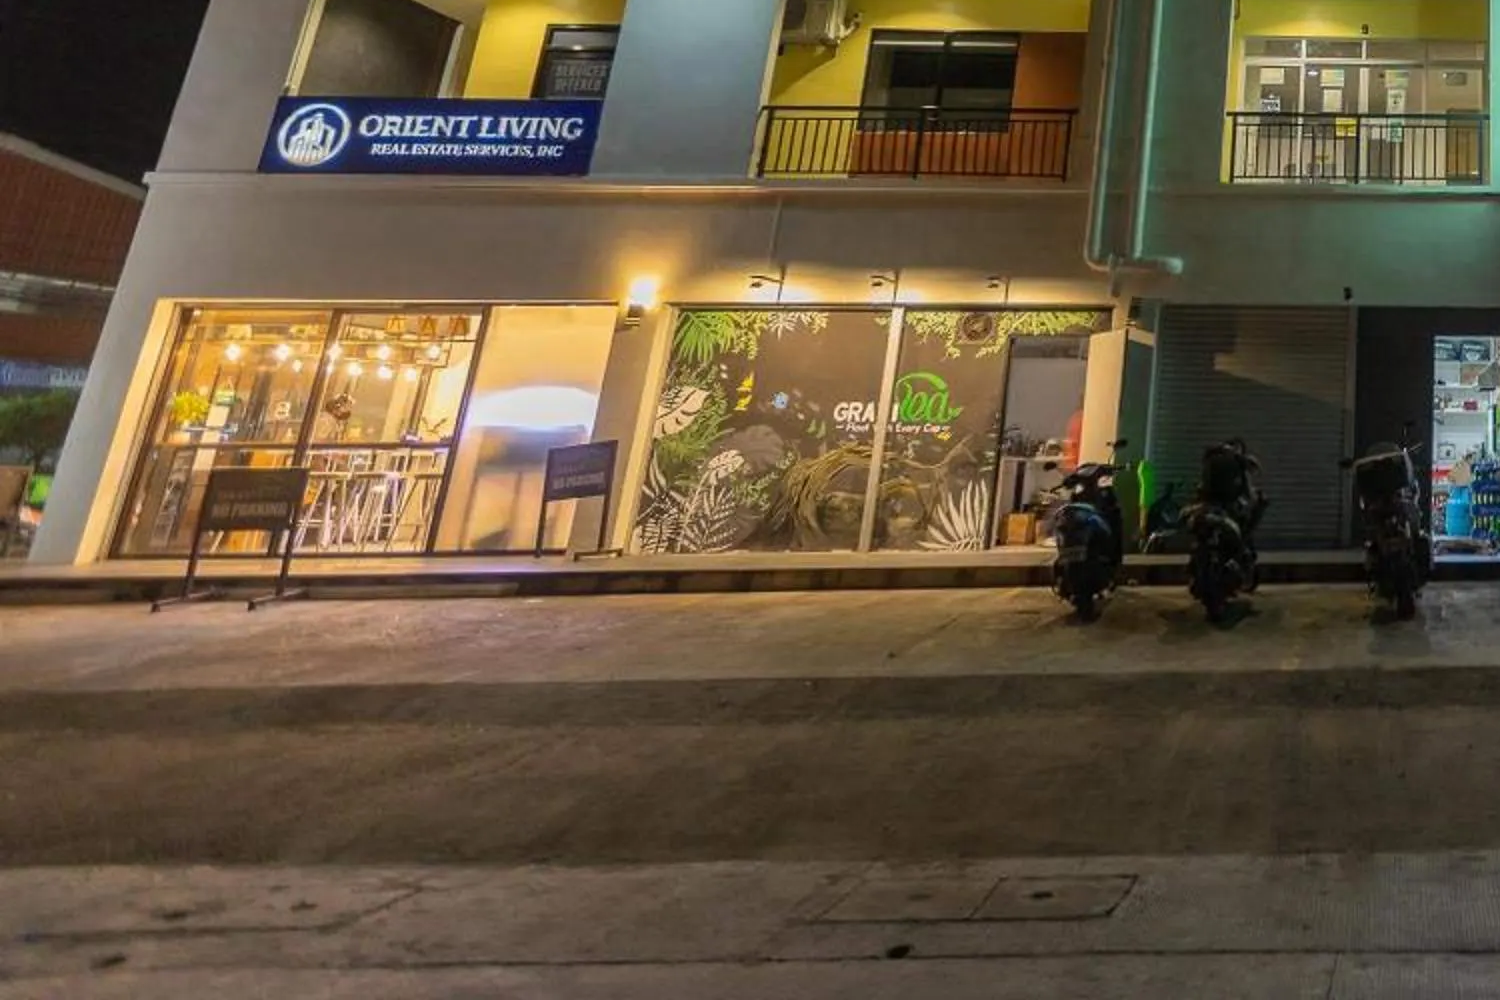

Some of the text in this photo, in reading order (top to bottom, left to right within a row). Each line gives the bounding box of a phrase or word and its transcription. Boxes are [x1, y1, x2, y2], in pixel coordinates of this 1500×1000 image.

[358, 114, 585, 140] ORIENT LIVING
[370, 143, 409, 156] REAL
